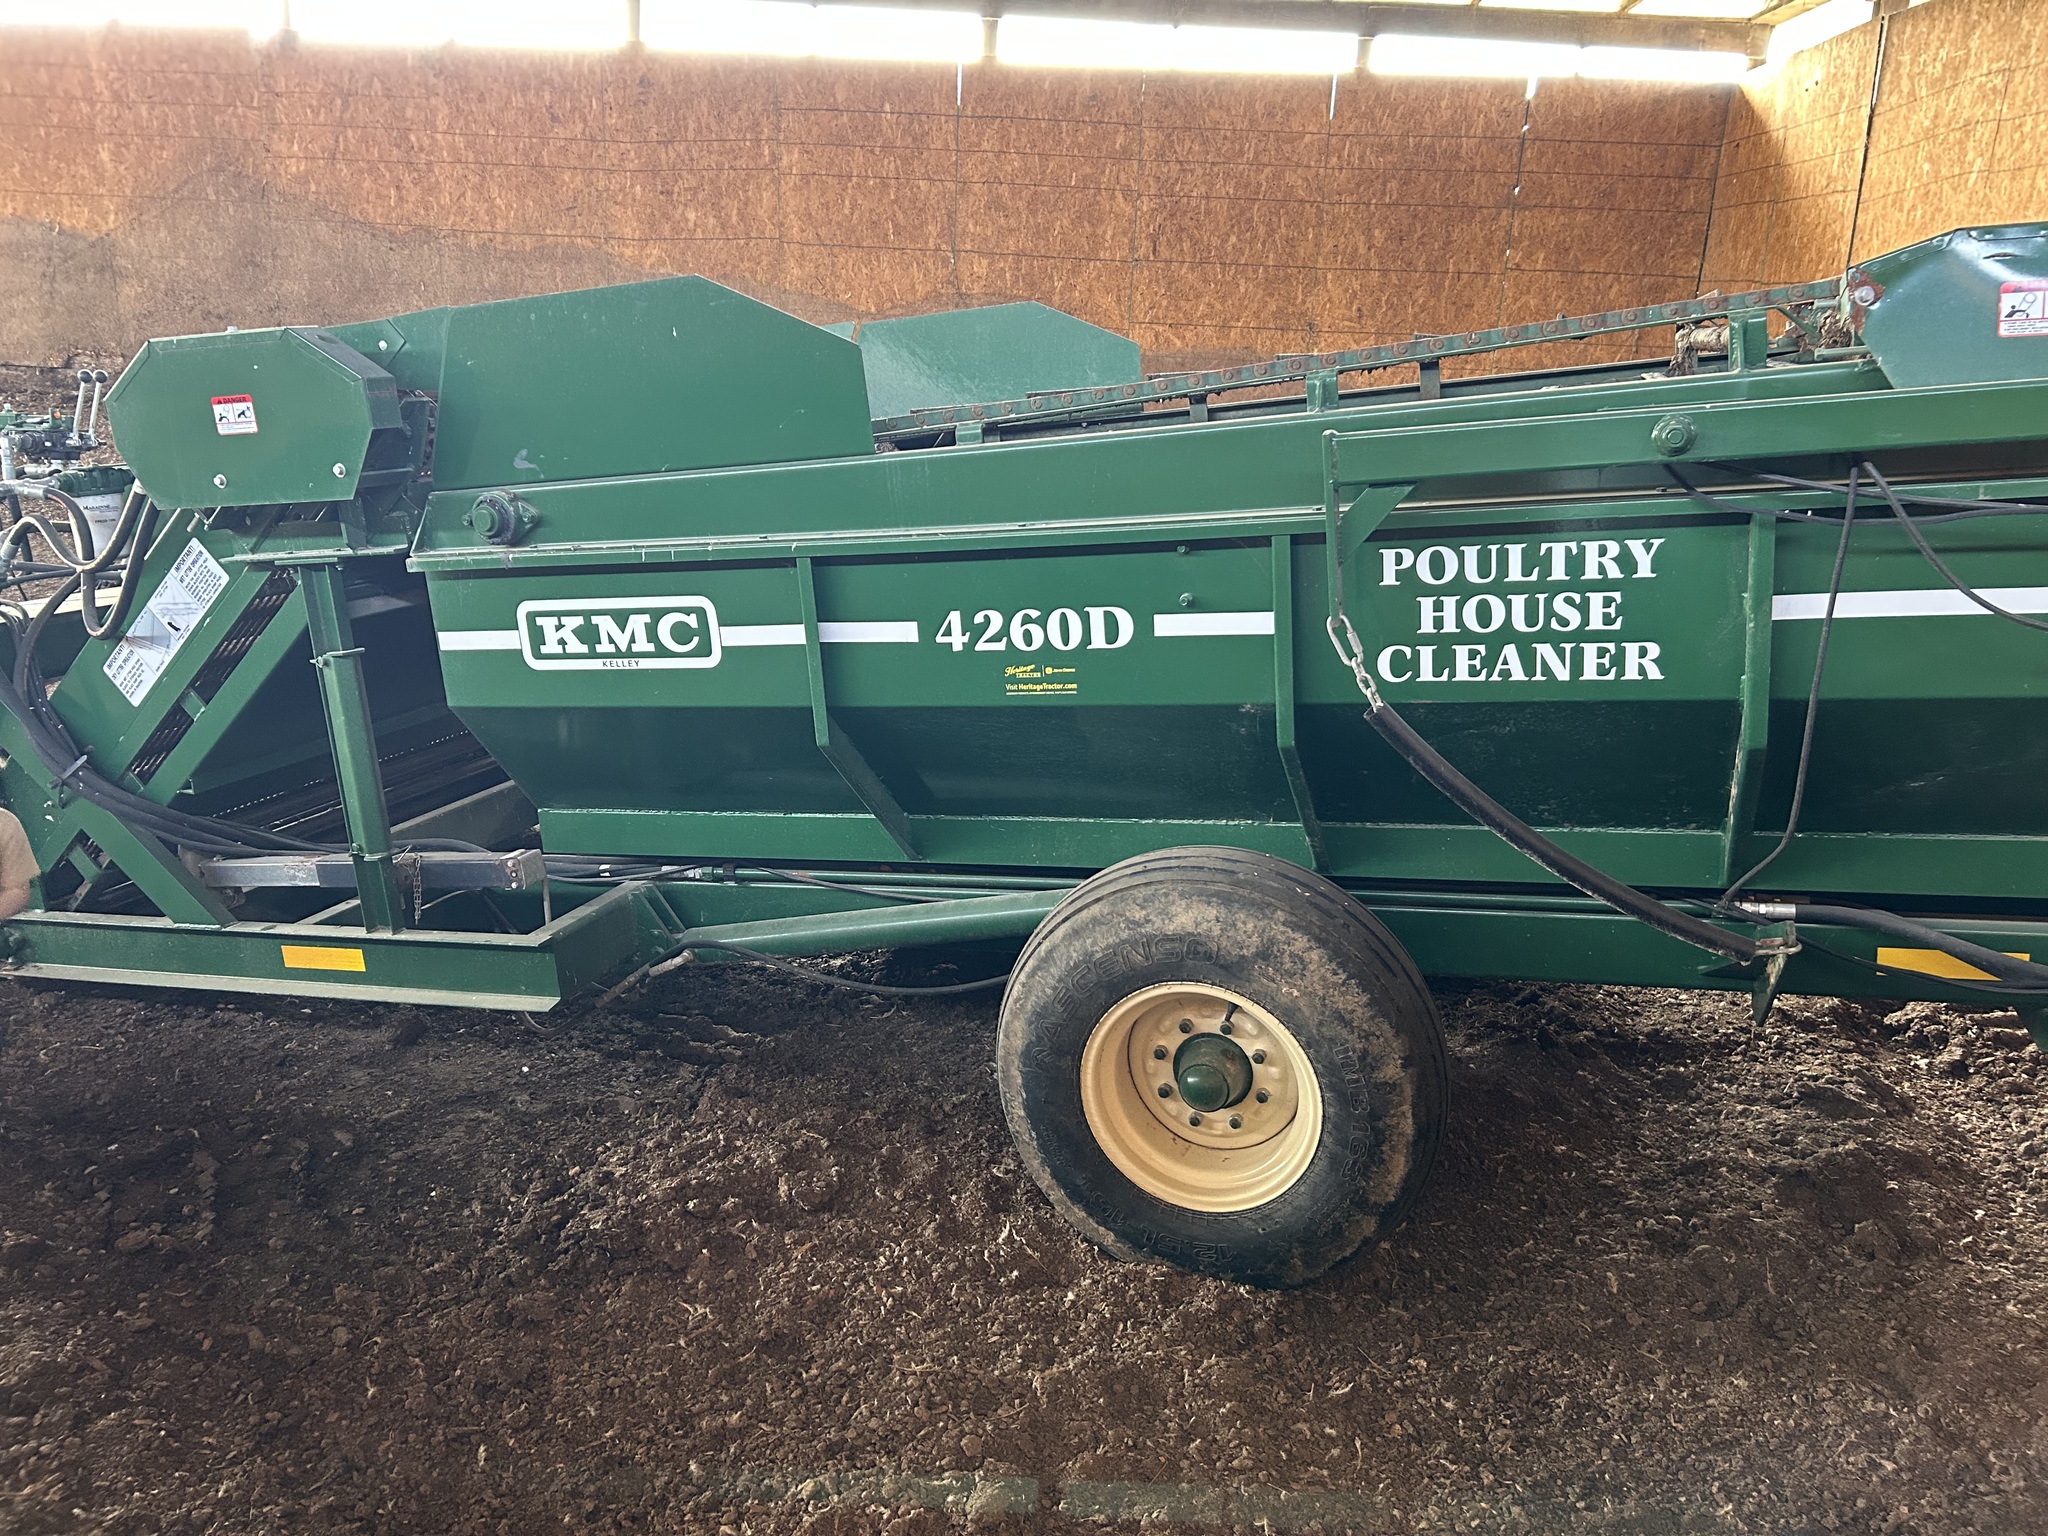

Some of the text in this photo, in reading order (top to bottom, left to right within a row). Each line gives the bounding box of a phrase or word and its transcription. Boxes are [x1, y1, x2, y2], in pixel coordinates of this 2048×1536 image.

[223, 396, 247, 404] DANGER
[173, 544, 194, 573] IMPORTANT!
[1379, 538, 1666, 586] POULTRY
[535, 612, 700, 654] KMC
[935, 606, 1134, 652] 4260D
[1416, 591, 1623, 634] HOUSE
[602, 660, 640, 668] KELLEY
[1376, 641, 1665, 683] CLEANER
[1018, 682, 1078, 691] HeritageTractor.com
[1039, 936, 1218, 1043] ASCENSO
